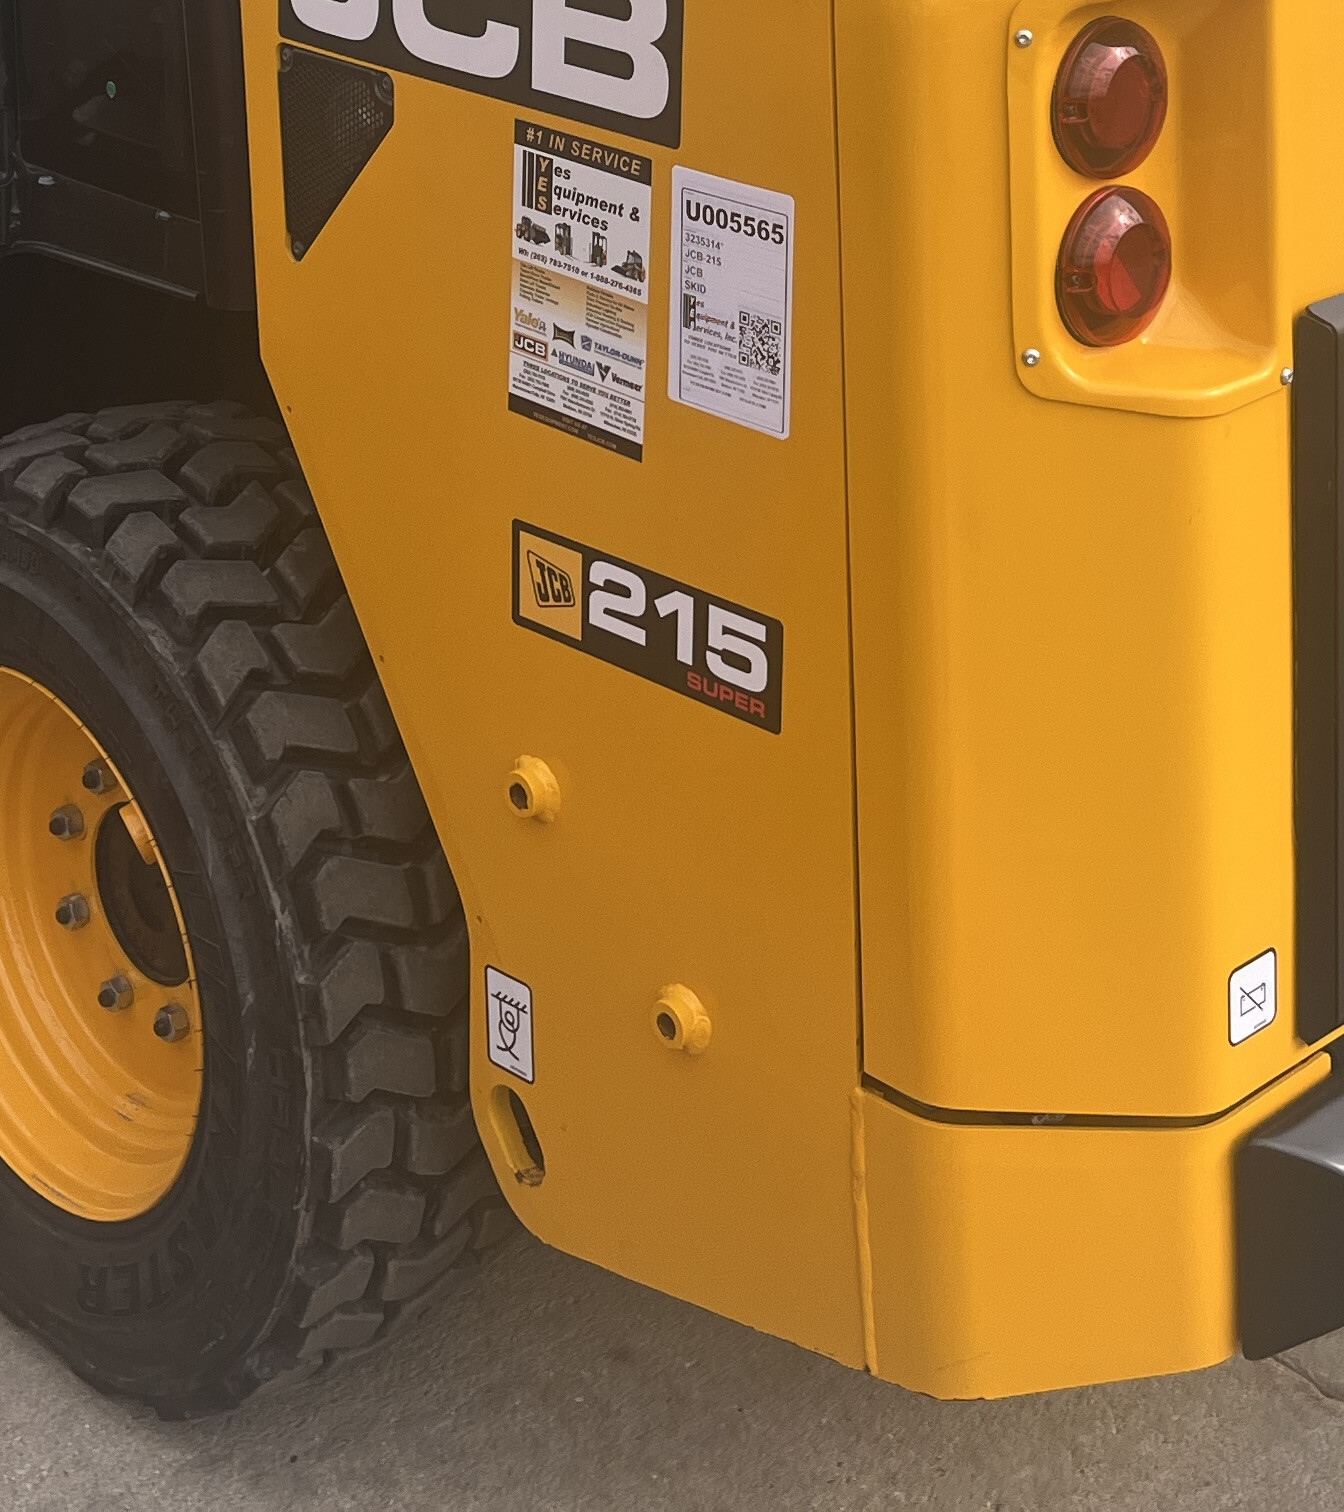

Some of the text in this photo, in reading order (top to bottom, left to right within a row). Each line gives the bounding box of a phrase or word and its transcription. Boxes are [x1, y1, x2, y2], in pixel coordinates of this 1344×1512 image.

[526, 127, 642, 176] #1 IN SERVICE
[629, 206, 641, 223] &
[686, 199, 785, 245] U005565
[684, 249, 704, 262] JCB
[684, 265, 704, 278] JCB
[684, 279, 707, 294] SKID
[515, 337, 547, 358] JCB
[535, 558, 572, 604] JCB
[588, 560, 768, 693] 215
[686, 671, 766, 719] SUPER
